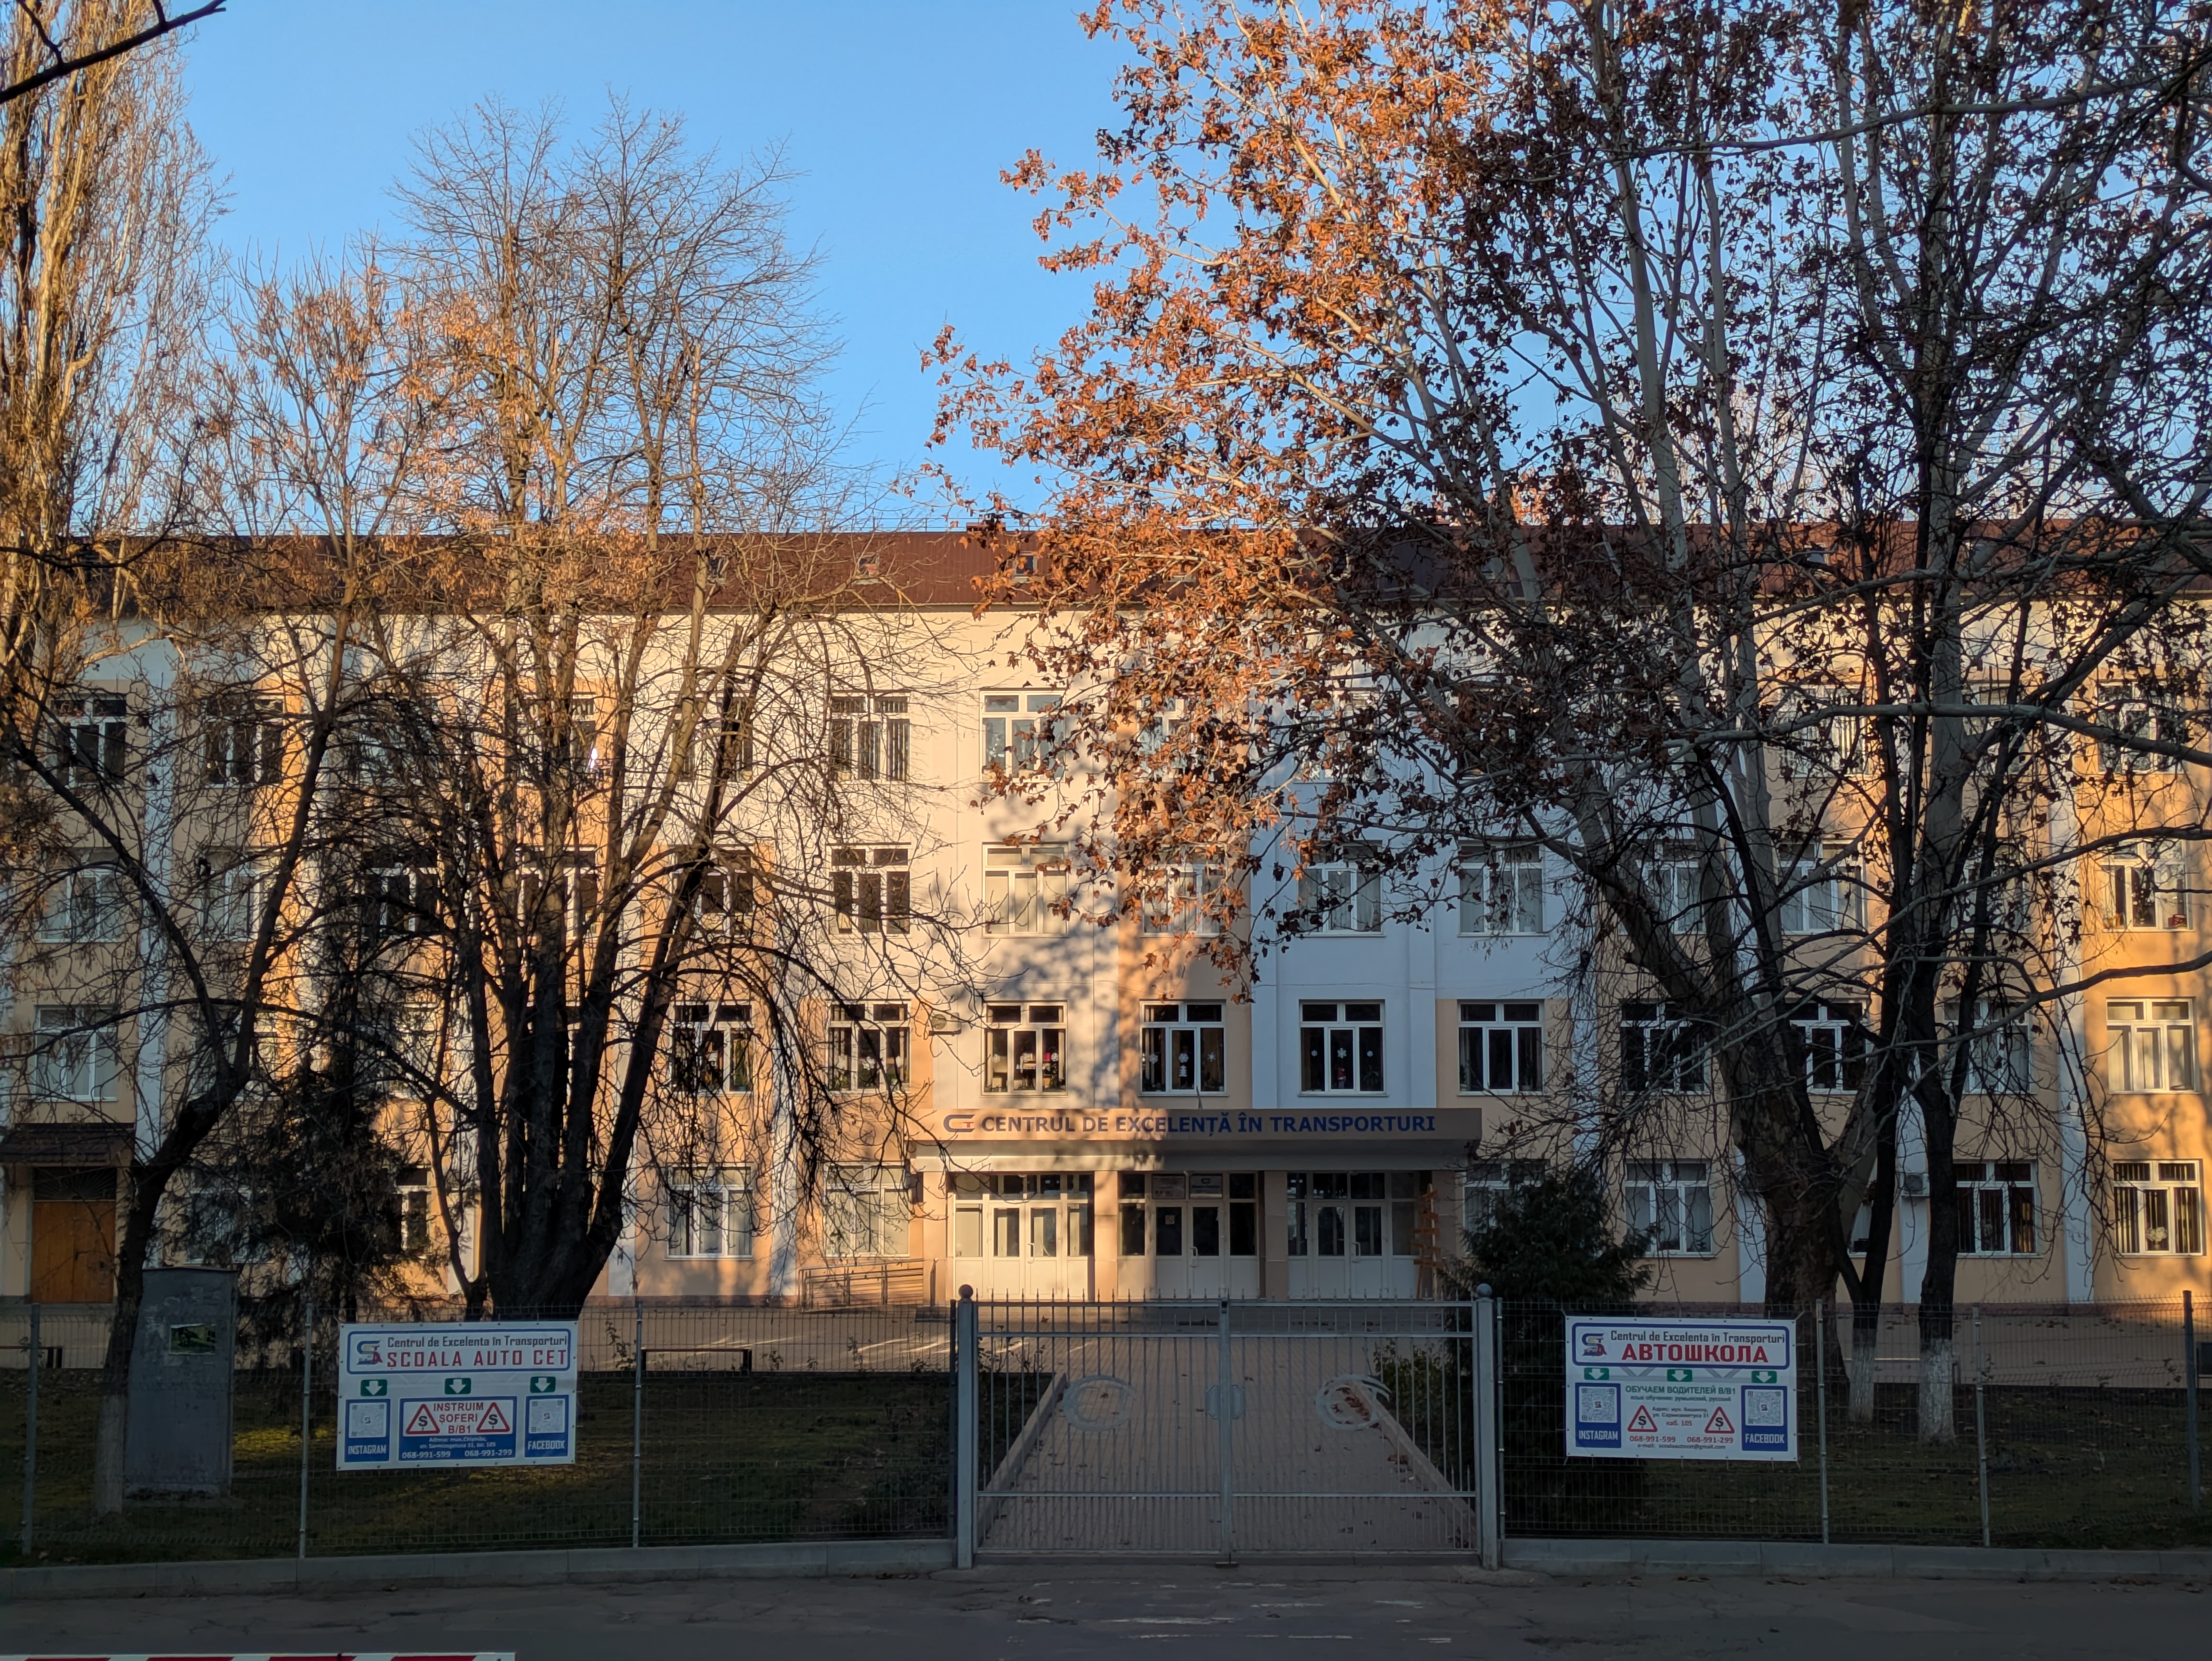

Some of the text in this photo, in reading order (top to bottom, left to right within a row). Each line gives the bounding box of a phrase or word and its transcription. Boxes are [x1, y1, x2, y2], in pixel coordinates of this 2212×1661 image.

[982, 1116, 1075, 1132] CENTRUL
[1083, 1116, 1108, 1132] DE
[1116, 1112, 1231, 1136] EXCELENȚĂ
[1238, 1113, 1262, 1132] ÎN
[1270, 1116, 1435, 1132] TRANSPORTURI
[387, 1337, 424, 1347] Centrul
[428, 1336, 439, 1347] de
[492, 1337, 501, 1346] în
[504, 1336, 566, 1347] Transporturi
[1611, 1330, 1646, 1341] Centrul
[1649, 1331, 1660, 1341] de
[1711, 1333, 1720, 1342] în
[1723, 1332, 1784, 1345] Transporturi
[474, 1351, 522, 1365] AUTO
[533, 1350, 566, 1365] CET
[1622, 1343, 1768, 1362] АВТОШКОЛА
[1667, 1385, 1716, 1395] ВОДИТЕЛЕЙ
[433, 1402, 484, 1411] INSTRUIM
[439, 1413, 477, 1425] ȘOFERI
[448, 1425, 471, 1434] B/B1
[1579, 1430, 1618, 1440] INSTAGRAM
[1745, 1433, 1785, 1444] FACEBOOK
[348, 1445, 387, 1455] INSTAGRAM
[528, 1440, 565, 1450] FACEBOOK
